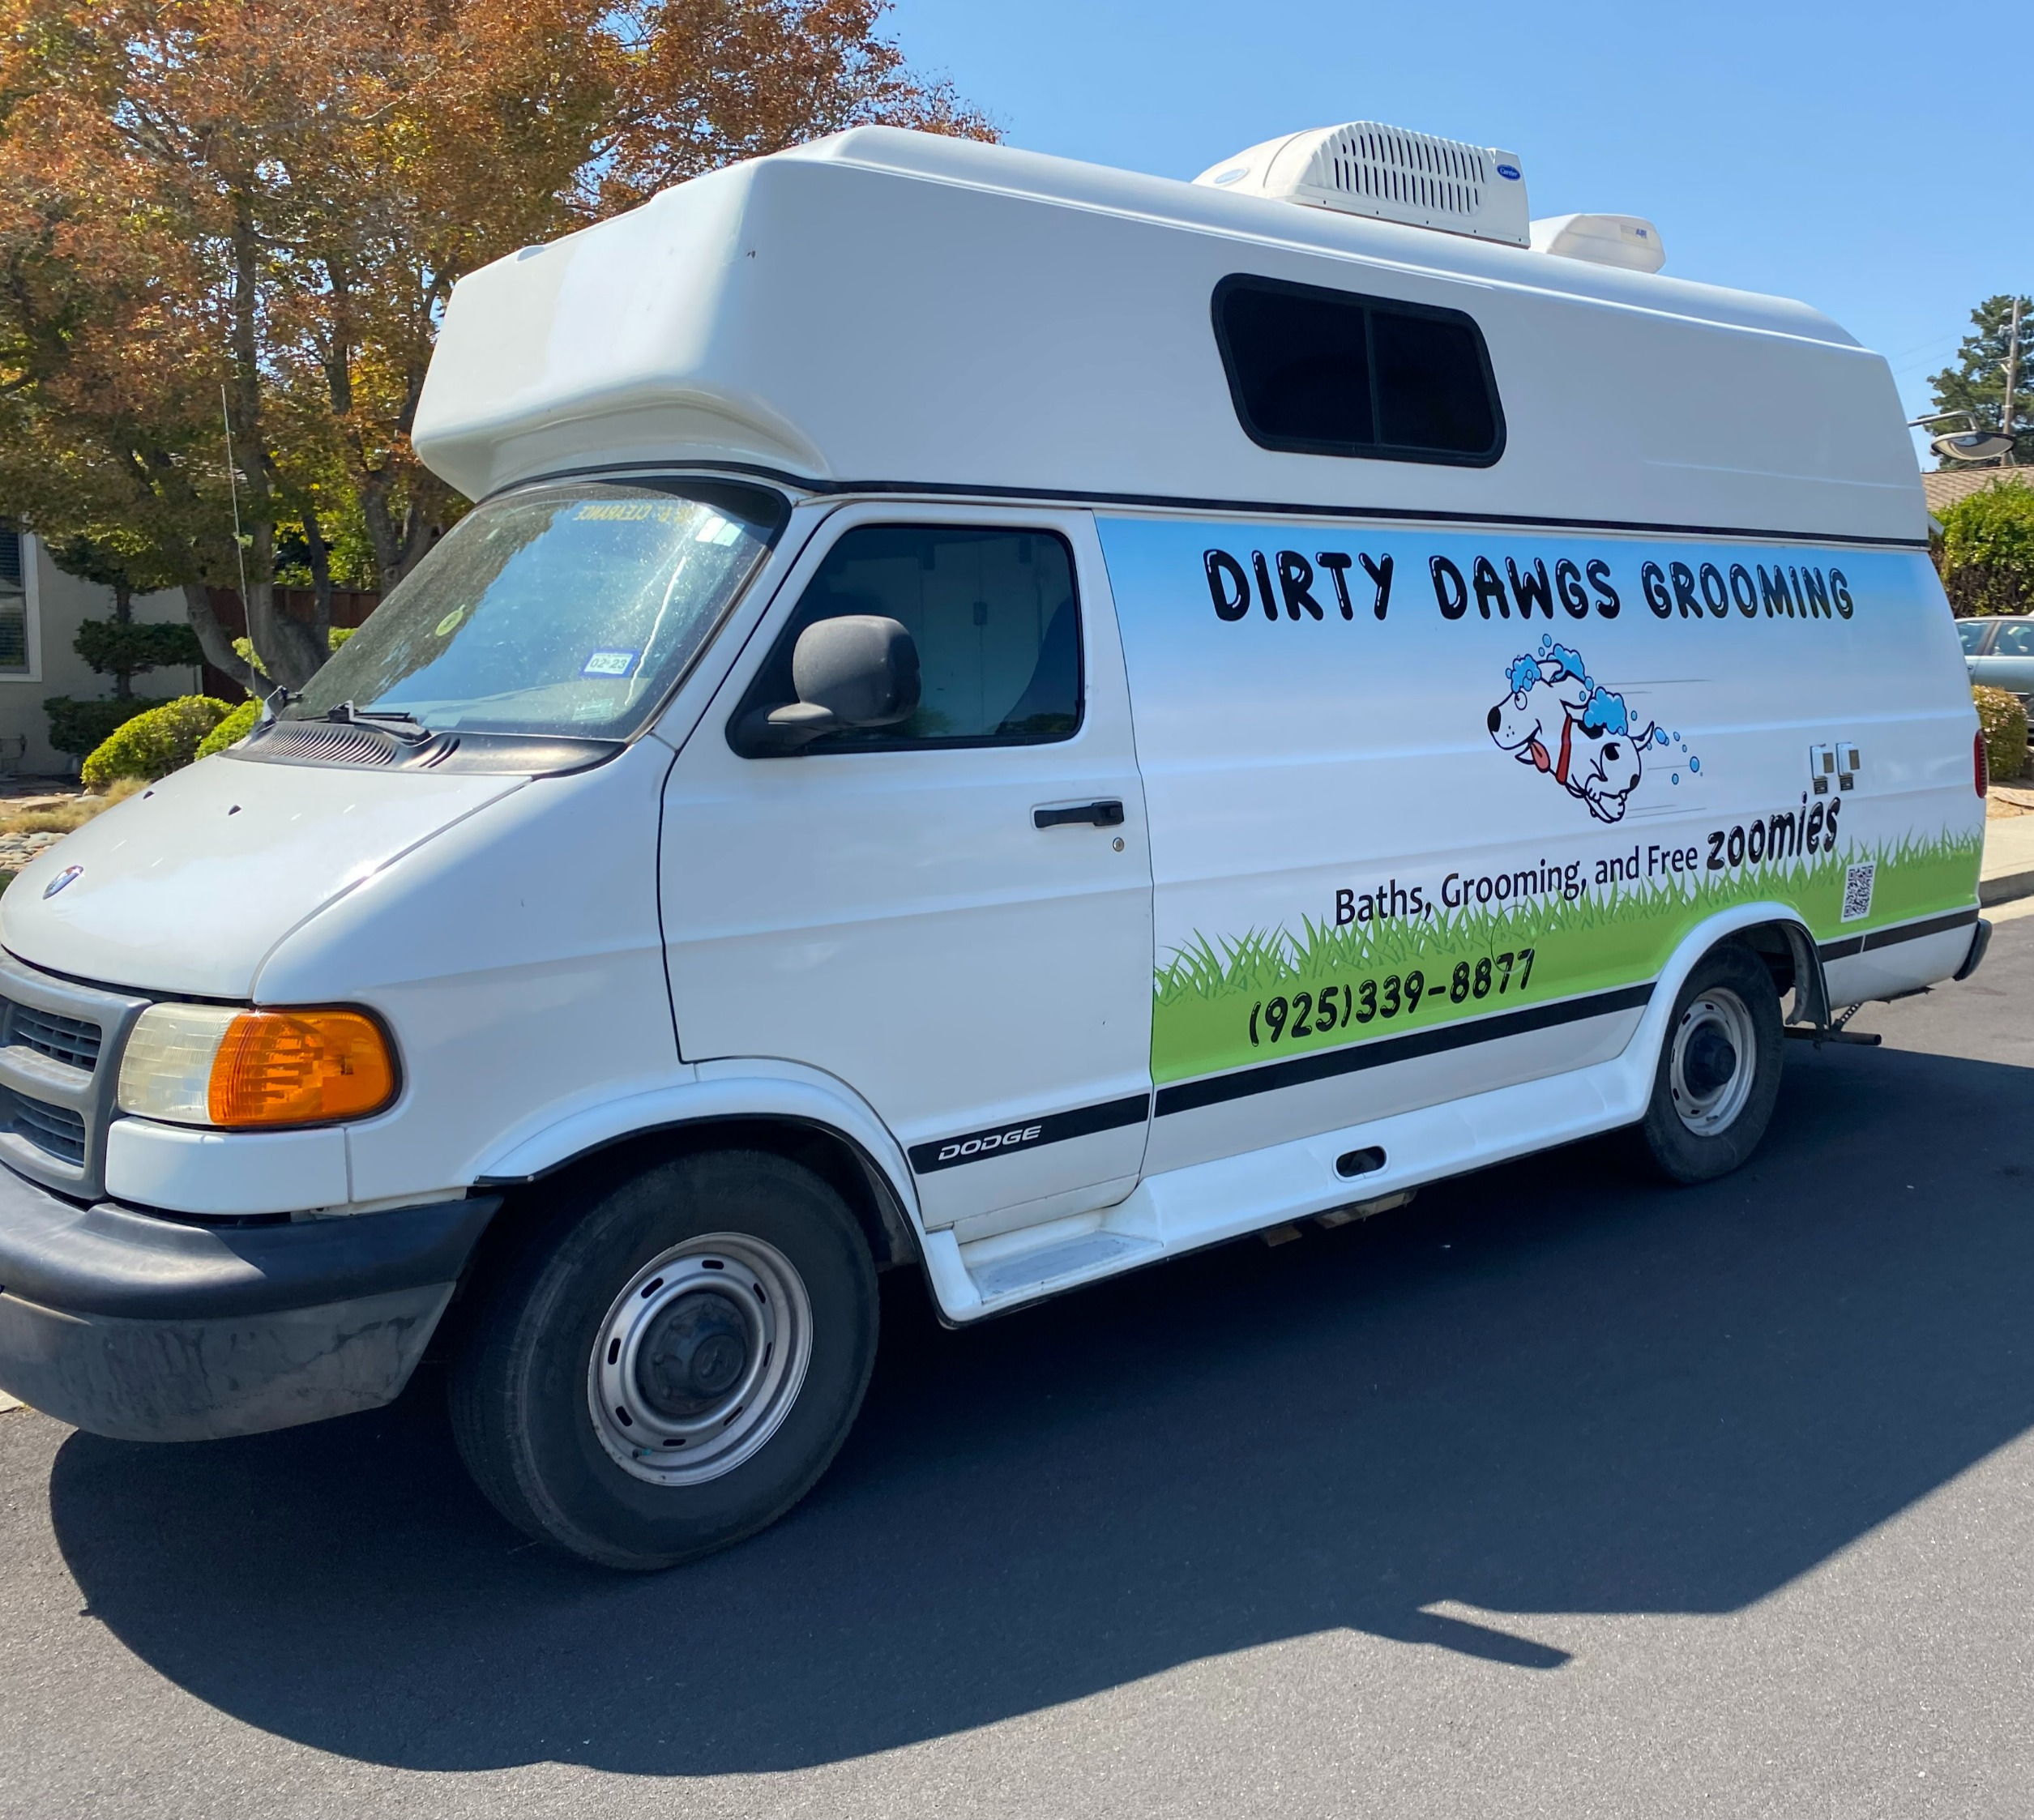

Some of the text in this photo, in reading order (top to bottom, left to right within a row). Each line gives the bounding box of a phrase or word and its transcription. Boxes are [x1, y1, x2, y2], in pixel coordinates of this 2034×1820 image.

[1203, 548, 1854, 622] DIRTY DAWGS GROOMING
[1335, 791, 1842, 926] Baths, Grooming, and Free zoomies
[1249, 948, 1535, 1047] (925)339-8877
[938, 1125, 1042, 1160] DODGE
